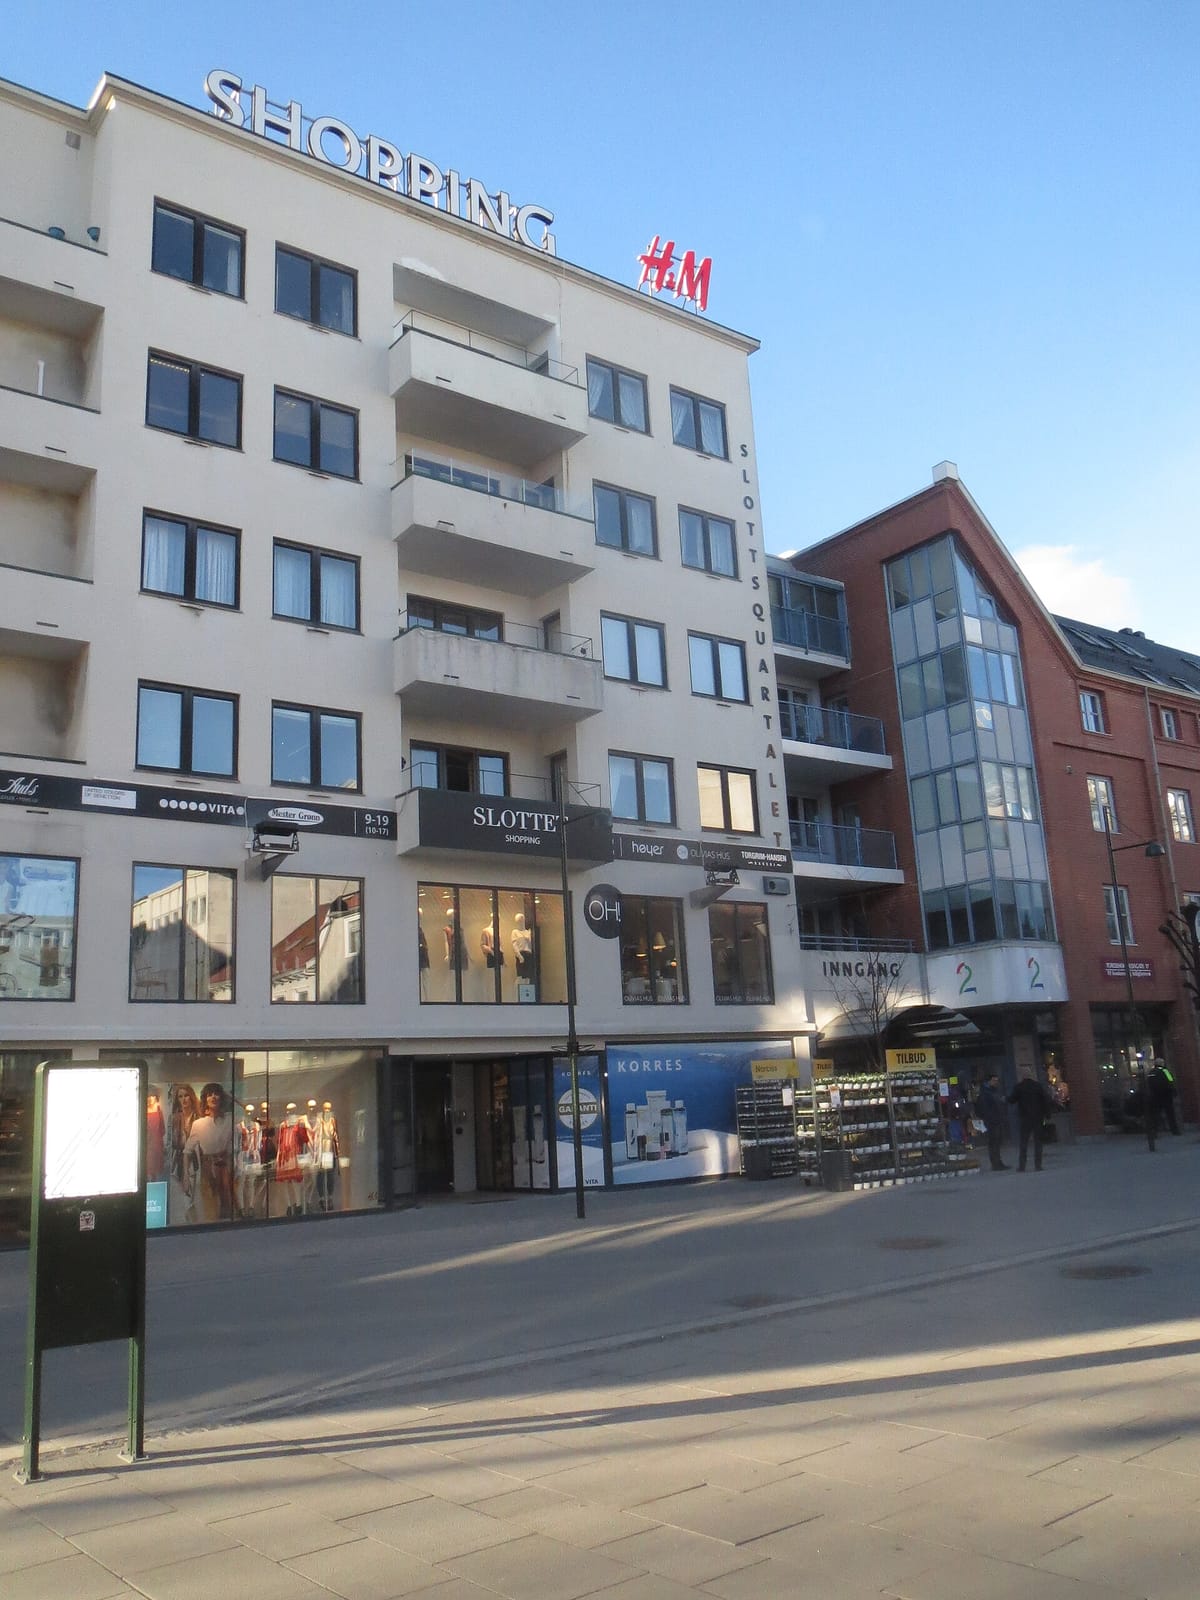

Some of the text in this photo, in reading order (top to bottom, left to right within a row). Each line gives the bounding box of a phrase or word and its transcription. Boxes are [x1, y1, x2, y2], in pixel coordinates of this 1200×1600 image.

[204, 69, 557, 255] SHOPPING
[638, 235, 712, 312] H&M
[740, 444, 782, 847] SLOTTSQUARTALET
[208, 803, 236, 816] VITA
[364, 813, 390, 826] 9-19
[365, 826, 389, 837] (10-17)
[505, 834, 541, 845] SHOPPING
[589, 900, 621, 922] OH!
[822, 961, 900, 978] INNGANG
[896, 1052, 926, 1064] TILBUD
[617, 1059, 682, 1072] KORRES
[558, 1105, 597, 1113] GAANTI
